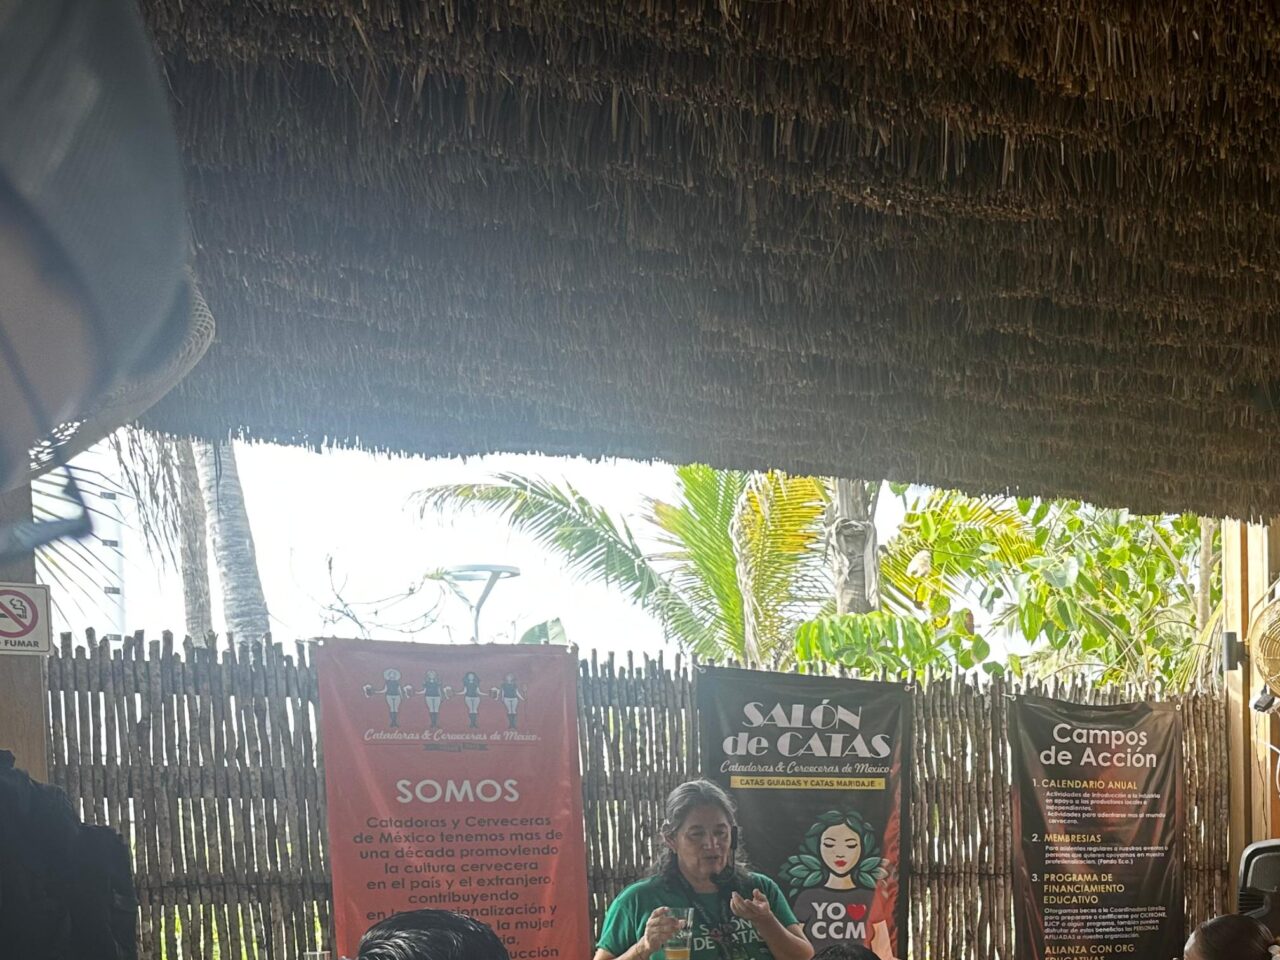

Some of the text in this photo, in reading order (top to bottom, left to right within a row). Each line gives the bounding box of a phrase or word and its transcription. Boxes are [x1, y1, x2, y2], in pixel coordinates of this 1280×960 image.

[4, 639, 40, 648] FUMAR
[742, 699, 862, 730] SALÓN
[364, 728, 420, 742] Catadoras
[422, 730, 432, 741] &
[490, 730, 501, 742] de
[1052, 723, 1148, 749] Campos
[722, 732, 891, 758] de CATAS
[1040, 746, 1157, 768] de Acción
[720, 760, 774, 774] Catadoras
[775, 762, 784, 773] &
[786, 762, 840, 774] Cerveceras
[842, 762, 852, 774] de
[740, 778, 765, 786] CATAS
[767, 779, 802, 787] GUIADAS
[836, 780, 876, 788] MARIDAJE
[1042, 779, 1105, 790] CALENDARIO
[1108, 782, 1138, 790] ANUAL
[396, 779, 520, 803] SOMOS
[366, 816, 551, 831] Catadoras y Cerveceras
[353, 829, 564, 844] de México tenemos mas de
[1032, 834, 1102, 842] 2. MEMBRESIAS
[360, 844, 559, 860] una década promoviendo
[384, 861, 538, 874] la cultura cervecera
[366, 879, 386, 890] en
[391, 877, 405, 890] el
[410, 876, 442, 892] país
[446, 880, 455, 891] y
[459, 875, 472, 888] el
[1032, 874, 1040, 882] 3.
[1044, 874, 1098, 882] PROGRAMA
[1044, 884, 1125, 893] FINANCIAMIENTO
[408, 890, 519, 905] contribuyendo
[1044, 896, 1098, 904] EDUCATIVO
[366, 911, 386, 920] en
[550, 904, 558, 915] y
[811, 902, 846, 920] YO
[496, 918, 554, 932] la mujer
[811, 922, 866, 940] CCM
[694, 937, 716, 951] DE
[1044, 946, 1087, 954] ALIANZA
[1090, 944, 1112, 954] CON
